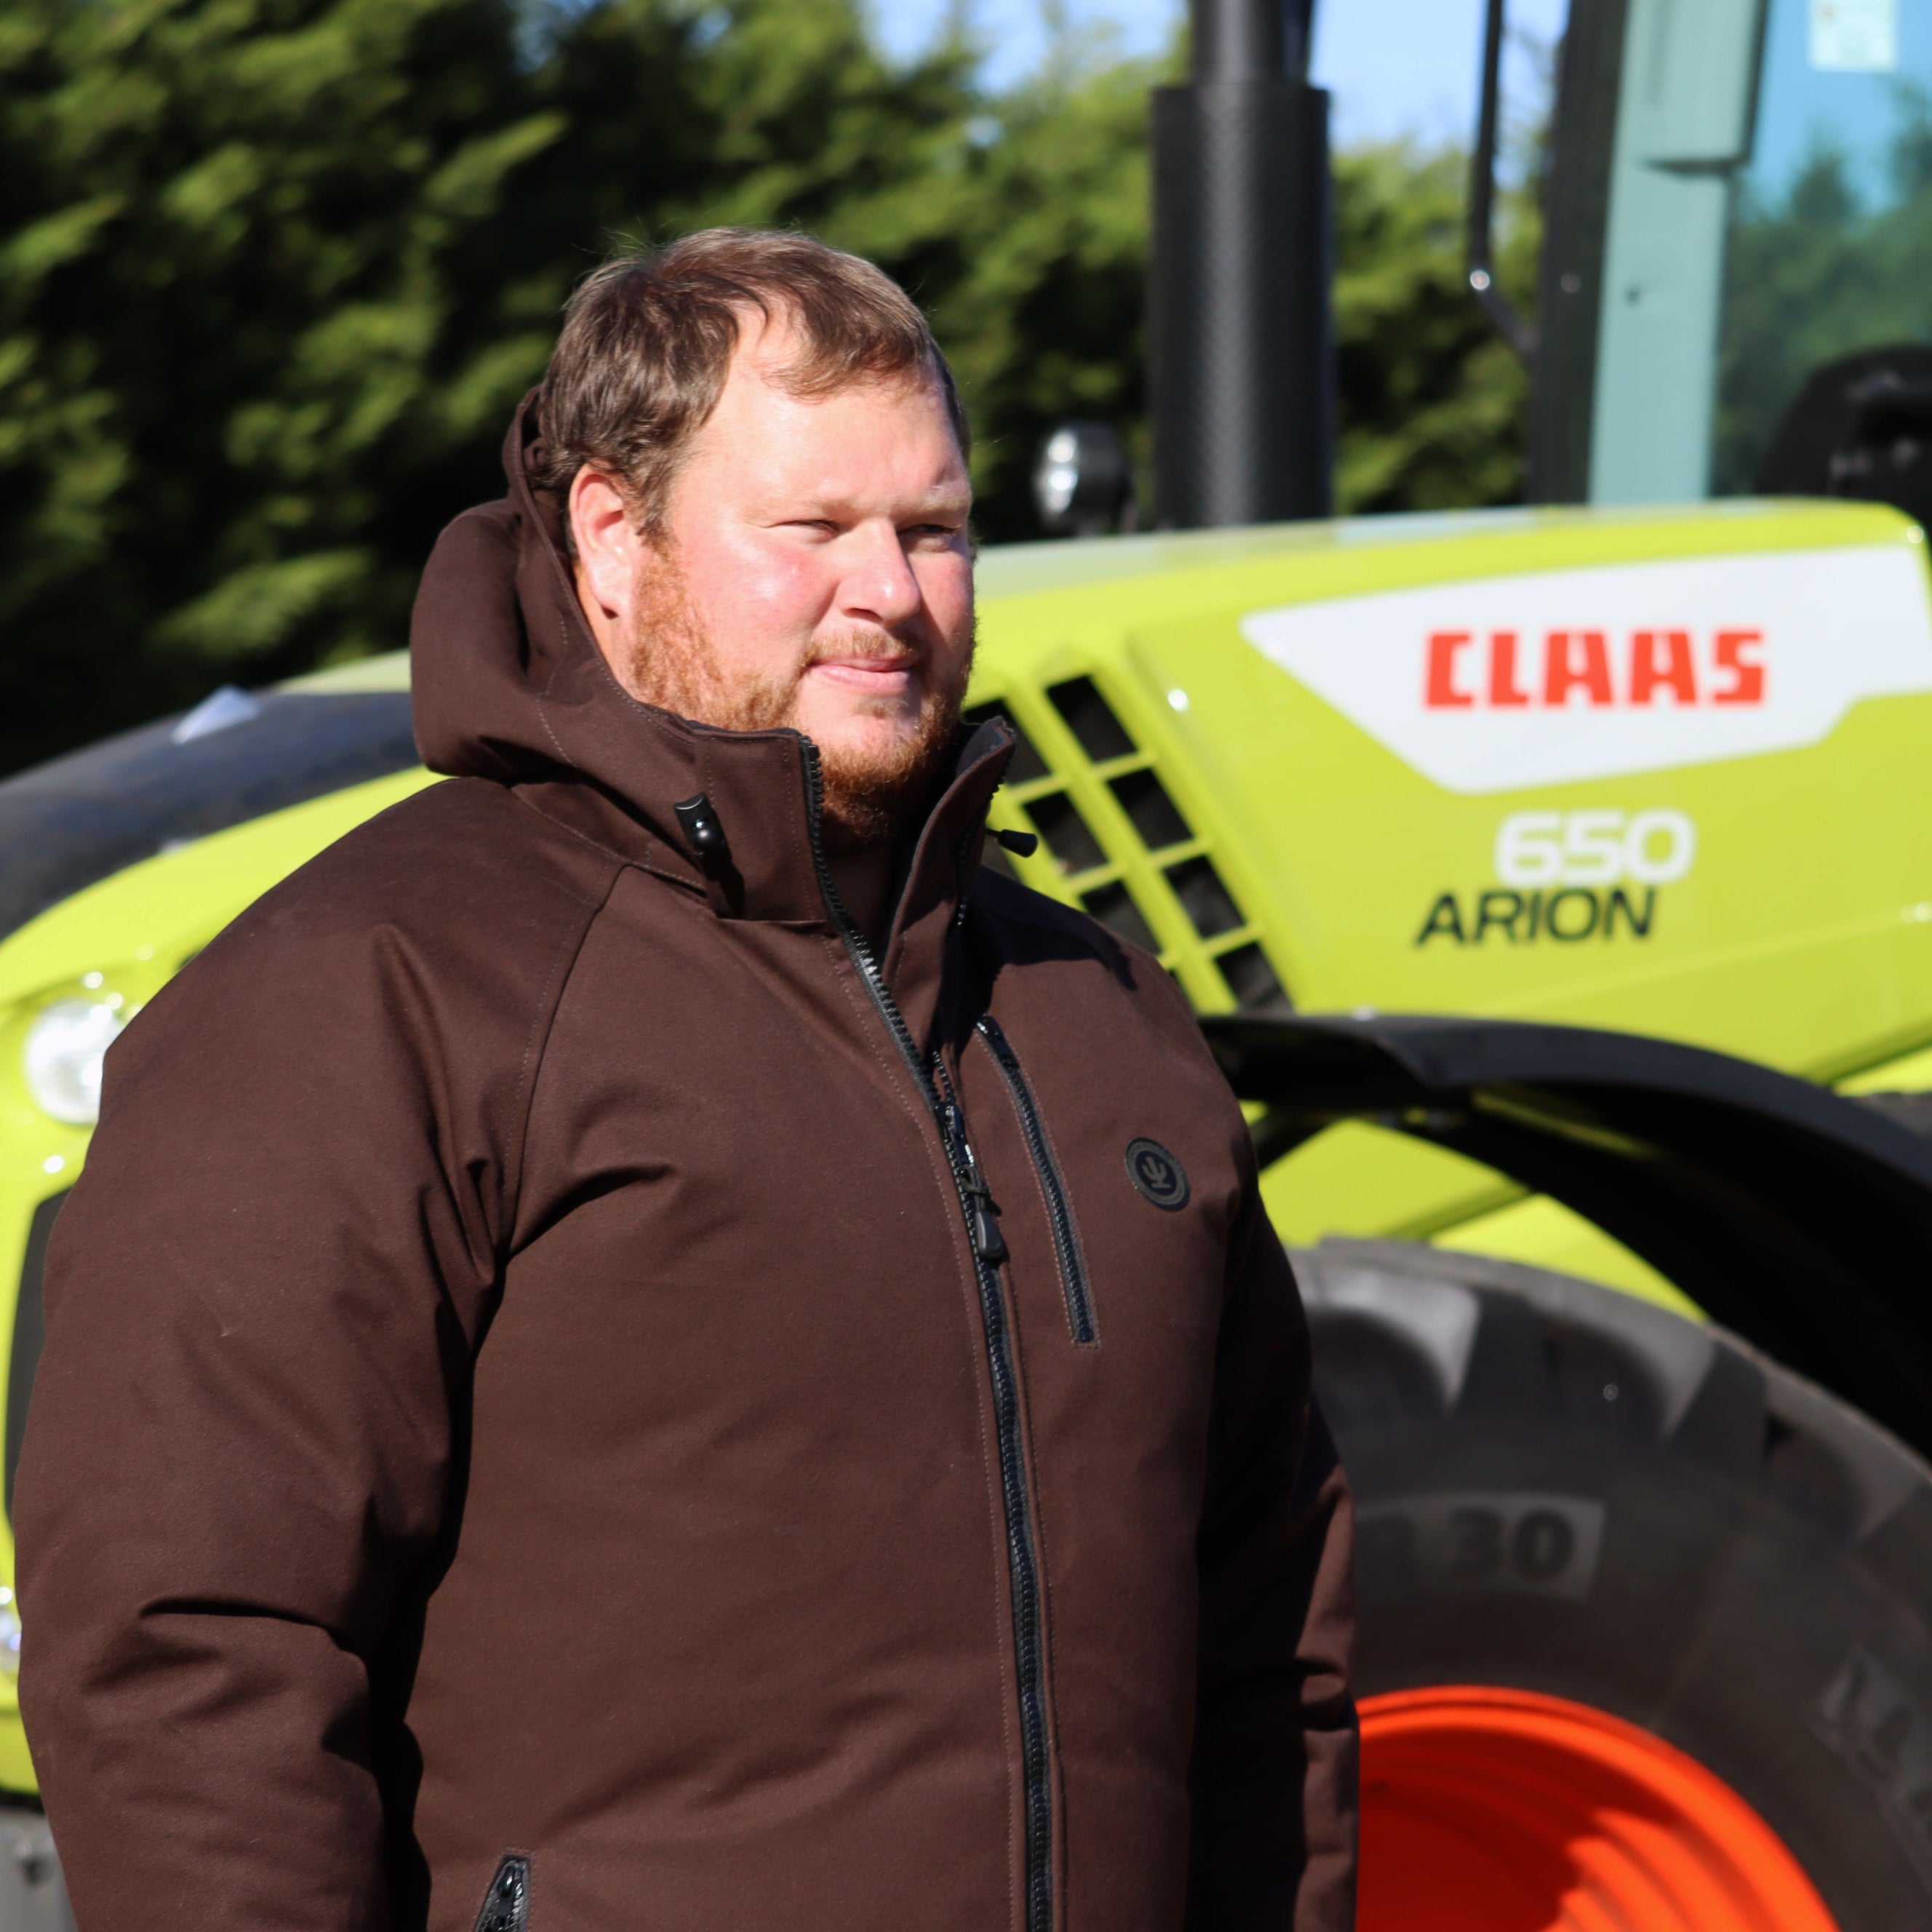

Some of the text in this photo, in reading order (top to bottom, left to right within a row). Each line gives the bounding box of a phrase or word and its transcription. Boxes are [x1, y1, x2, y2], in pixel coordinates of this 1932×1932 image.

[1424, 628, 1765, 709] CLAAS
[1493, 807, 1697, 888] 650
[1413, 885, 1656, 946] ARION
